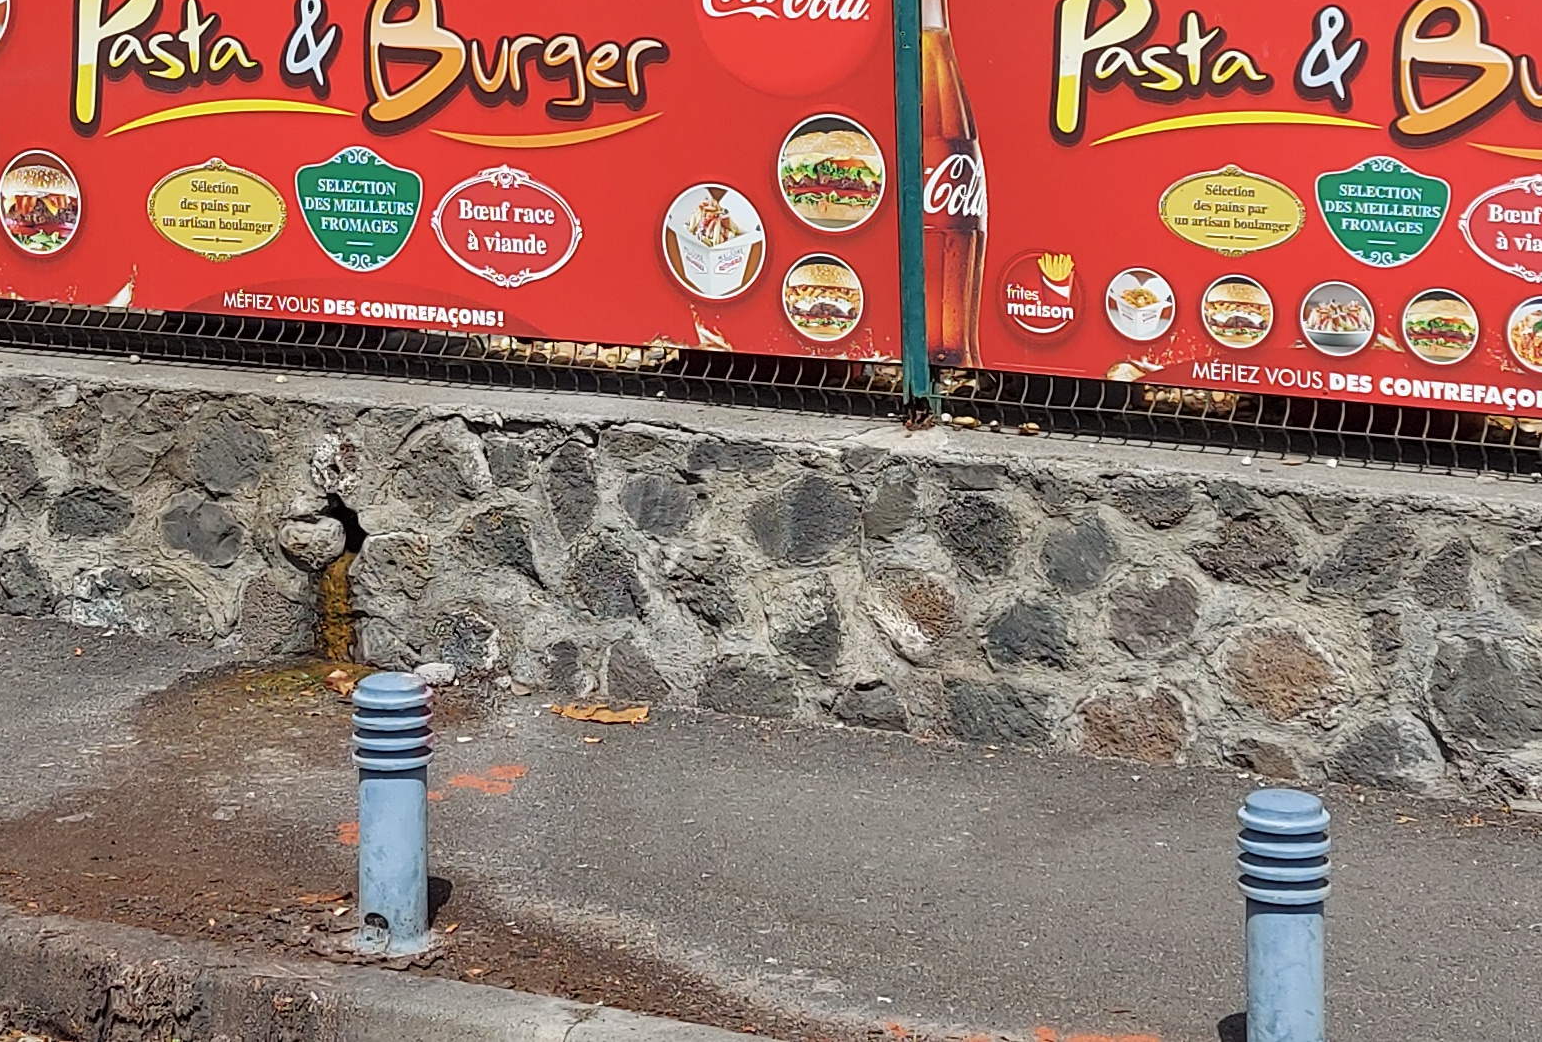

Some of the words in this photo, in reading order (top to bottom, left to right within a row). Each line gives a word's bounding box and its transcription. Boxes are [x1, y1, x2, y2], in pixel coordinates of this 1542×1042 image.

[1300, 5, 1363, 102] &
[190, 179, 239, 196] Sélection
[317, 177, 397, 197] SELECTION
[1204, 183, 1255, 199] Sélection
[1339, 183, 1424, 202] SELECTION
[180, 197, 198, 211] des
[200, 199, 229, 215] pains
[231, 201, 252, 216] par
[305, 196, 331, 211] DES
[333, 197, 415, 216] MEILLEURS
[457, 197, 510, 223] Bœuf
[512, 205, 556, 226] race
[1194, 199, 1213, 214] des
[1215, 201, 1246, 217] pains
[1247, 203, 1269, 218] par
[1325, 199, 1353, 215] DES
[1355, 201, 1442, 219] MEILLEURS
[162, 216, 176, 227] un
[178, 215, 217, 230] artisan
[218, 217, 274, 235] boulanger
[320, 217, 399, 235] FROMAGES
[1174, 215, 1189, 226] un
[1190, 214, 1231, 230] artisan
[1233, 217, 1292, 234] boulanger
[1340, 218, 1424, 235] FROMAGES
[468, 230, 480, 253] à
[483, 231, 548, 255] viande
[1496, 231, 1509, 250] à
[1007, 284, 1039, 301] frites
[223, 288, 273, 311] MÉFIEZ
[275, 296, 320, 314] VOUS
[323, 300, 357, 316] DES
[359, 303, 504, 329] CONTREFAÇONS!
[1007, 301, 1074, 320] maison
[1192, 356, 1260, 385] MÉFIEZ
[1264, 366, 1323, 390] VOUS
[1329, 371, 1373, 394] DES
